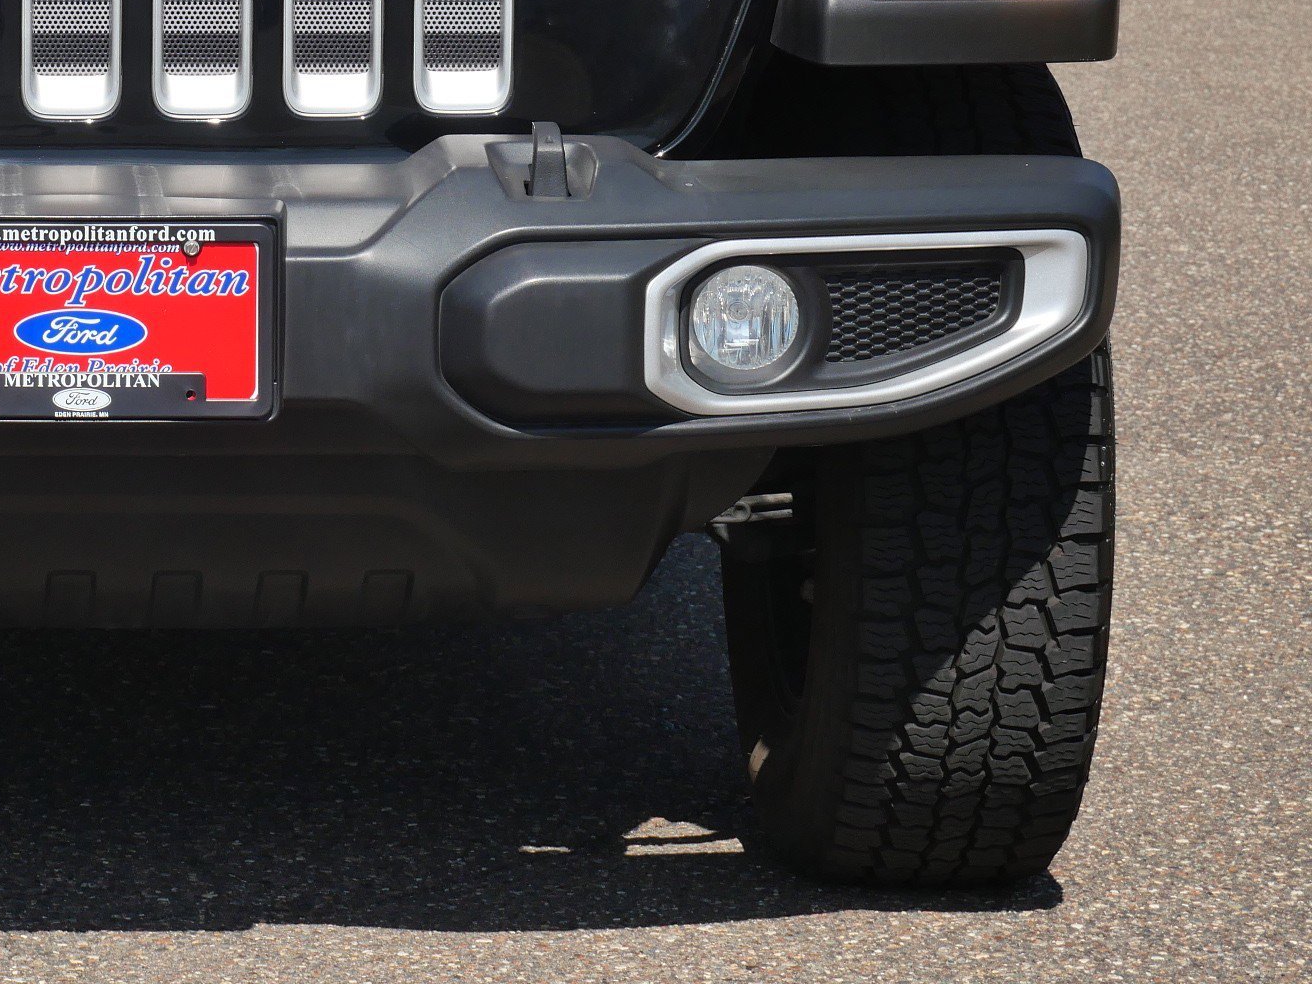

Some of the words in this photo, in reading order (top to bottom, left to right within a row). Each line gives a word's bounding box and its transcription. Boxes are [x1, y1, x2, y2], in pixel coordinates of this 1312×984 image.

[41, 315, 119, 347] Ford
[3, 373, 161, 388] METROPOLITAN
[65, 391, 99, 407] Ford
